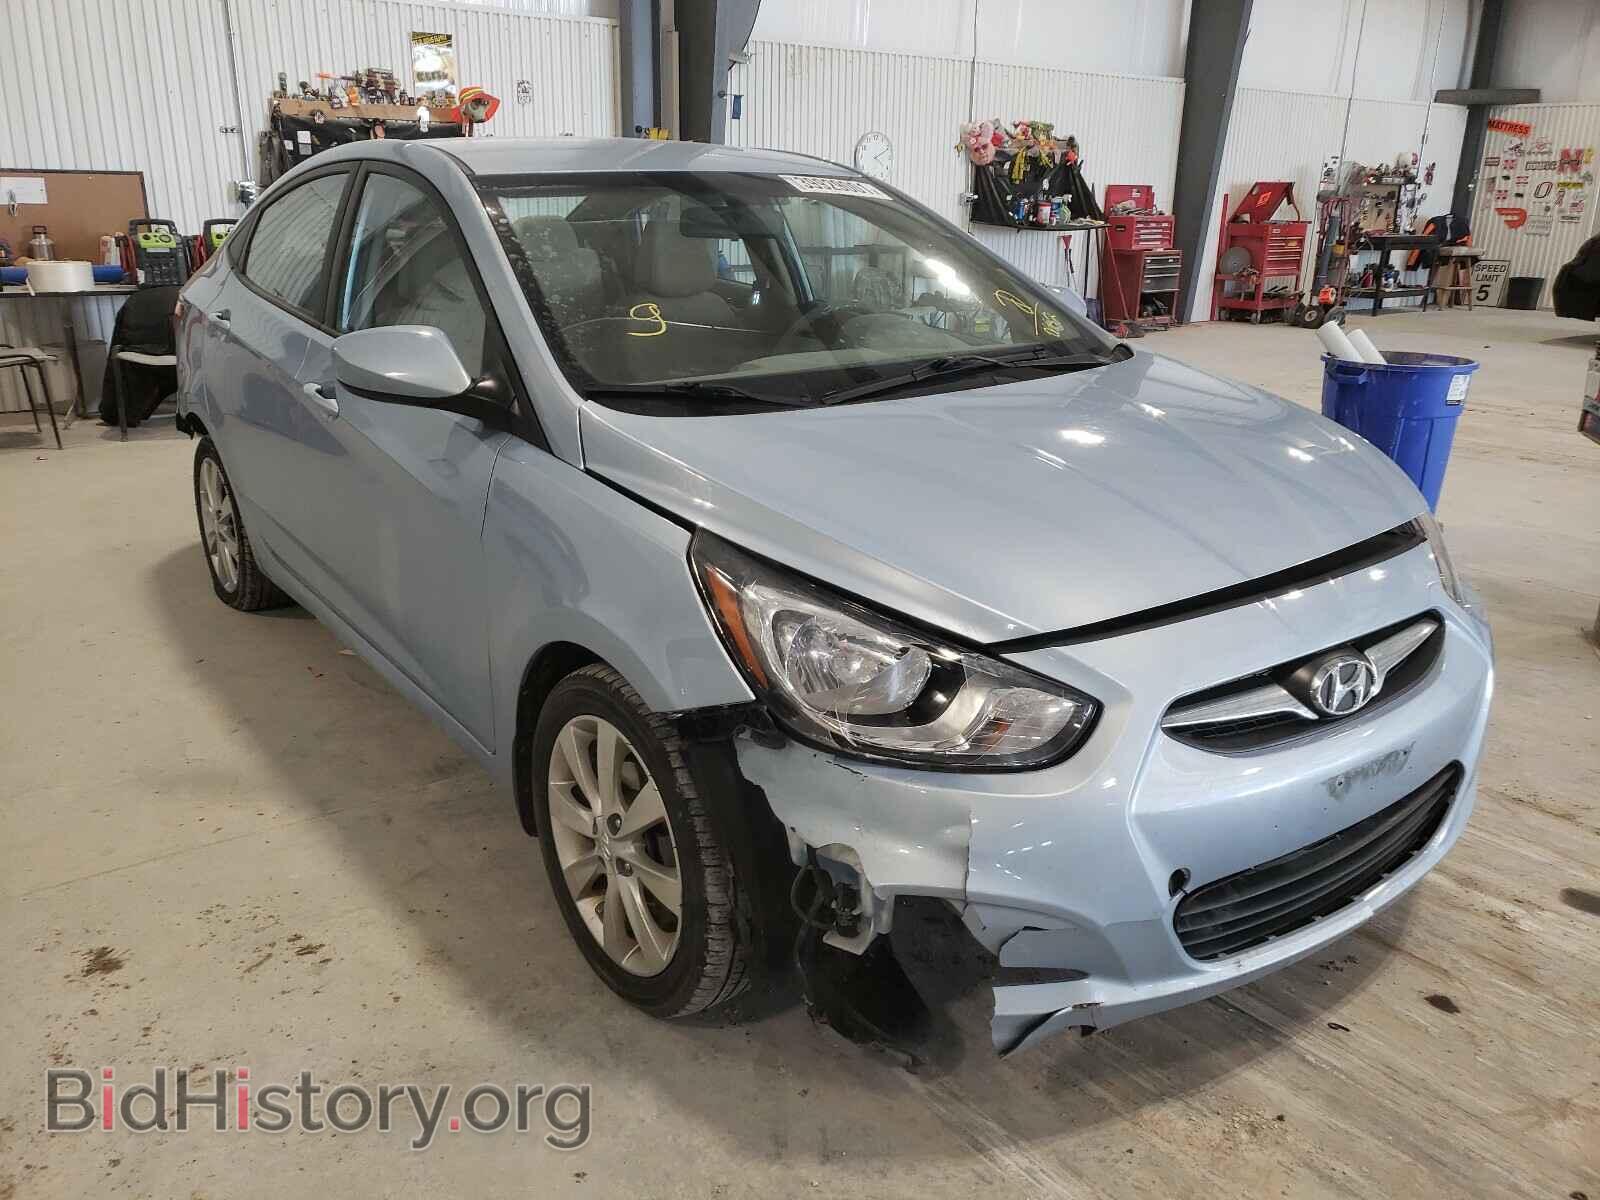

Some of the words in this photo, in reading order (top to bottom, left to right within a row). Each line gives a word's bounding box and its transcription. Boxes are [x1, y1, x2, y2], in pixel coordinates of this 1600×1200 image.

[1488, 119, 1530, 135] MATTRESS
[1474, 264, 1506, 273] SPEED
[1475, 273, 1498, 283] LIMIT
[1475, 284, 1491, 302] 5
